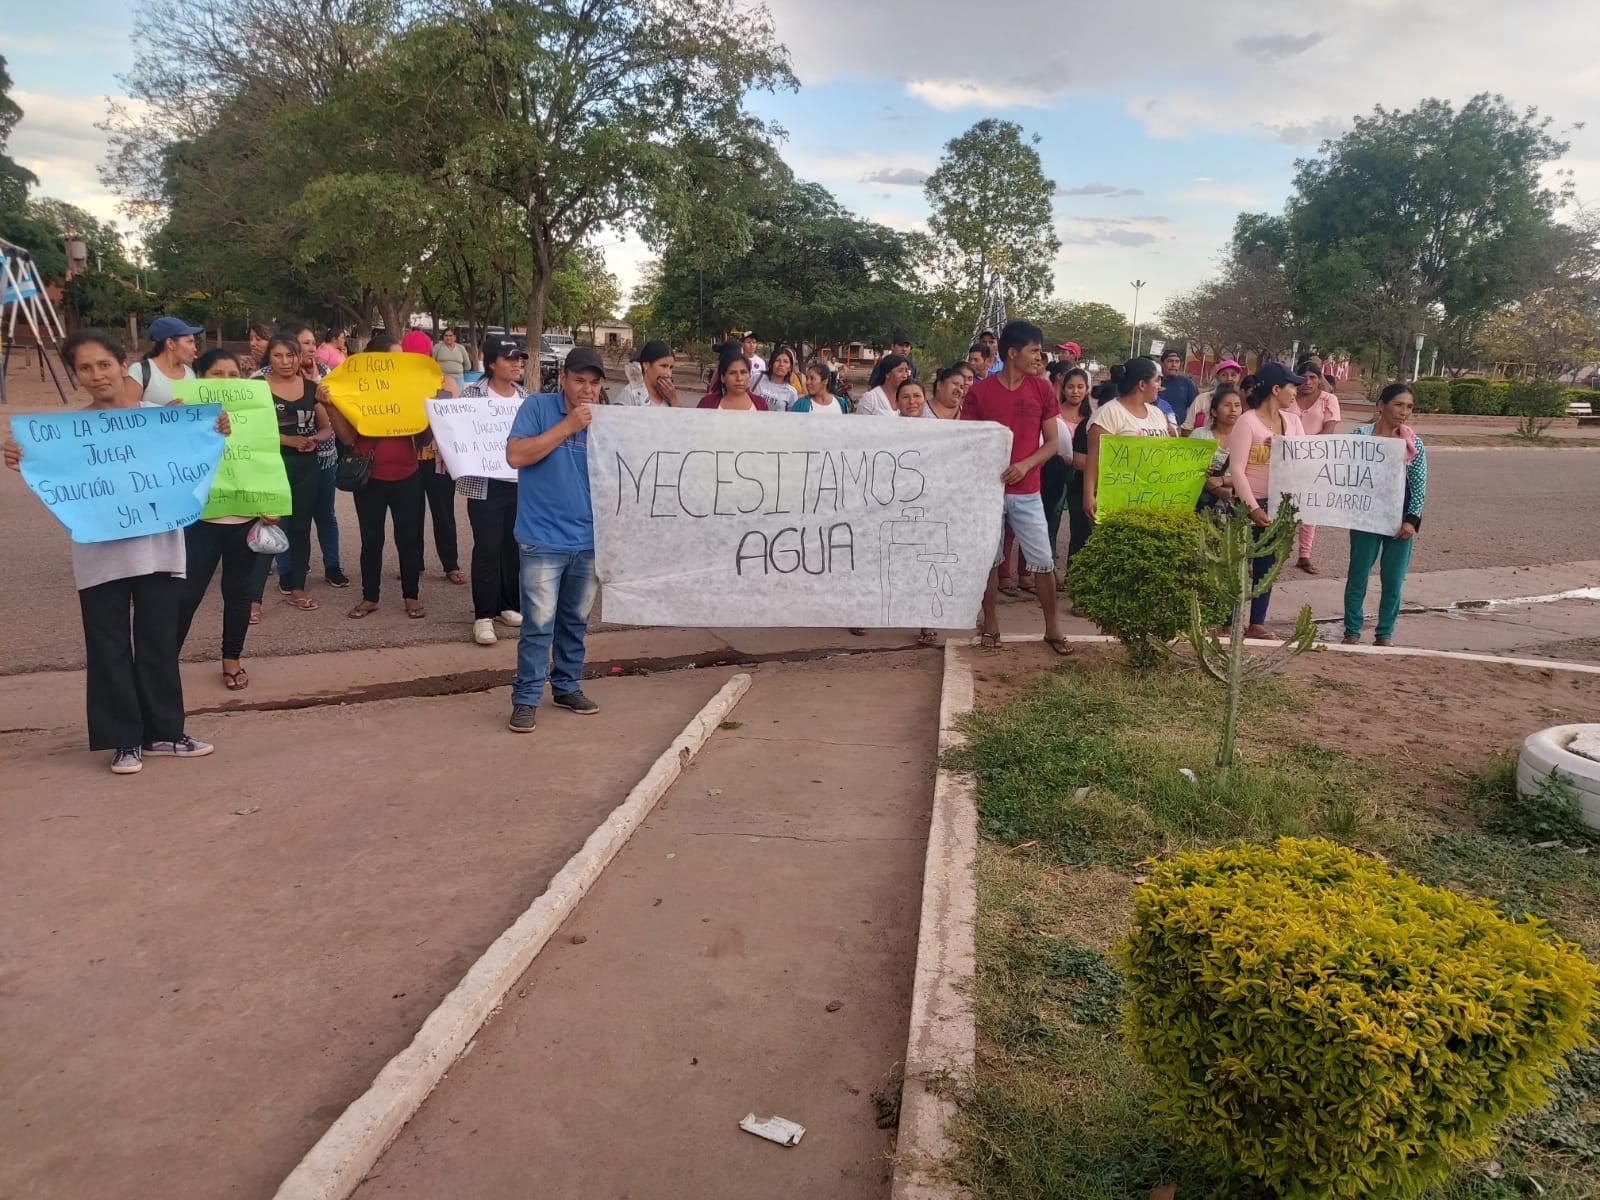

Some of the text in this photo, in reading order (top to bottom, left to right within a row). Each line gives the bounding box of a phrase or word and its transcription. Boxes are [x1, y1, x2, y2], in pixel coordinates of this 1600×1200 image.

[366, 355, 395, 373] AGUA
[198, 385, 254, 404] QUEREMOS
[359, 377, 390, 392] ES UN
[360, 403, 401, 417] ERECHO
[29, 408, 203, 442] CON LA SALUD NO SE
[82, 443, 136, 466] JUEGA
[1108, 443, 1129, 468] YA
[1138, 447, 1164, 468] NO
[1282, 439, 1386, 463] NESESITAMOS
[128, 471, 163, 494] DEL
[167, 461, 210, 486] AGUA
[615, 450, 925, 518] NECESITAMOS
[1313, 463, 1374, 489] AGUA
[1306, 492, 1321, 507] EL
[1326, 492, 1372, 511] BARRIO
[736, 522, 855, 576] AGUA
